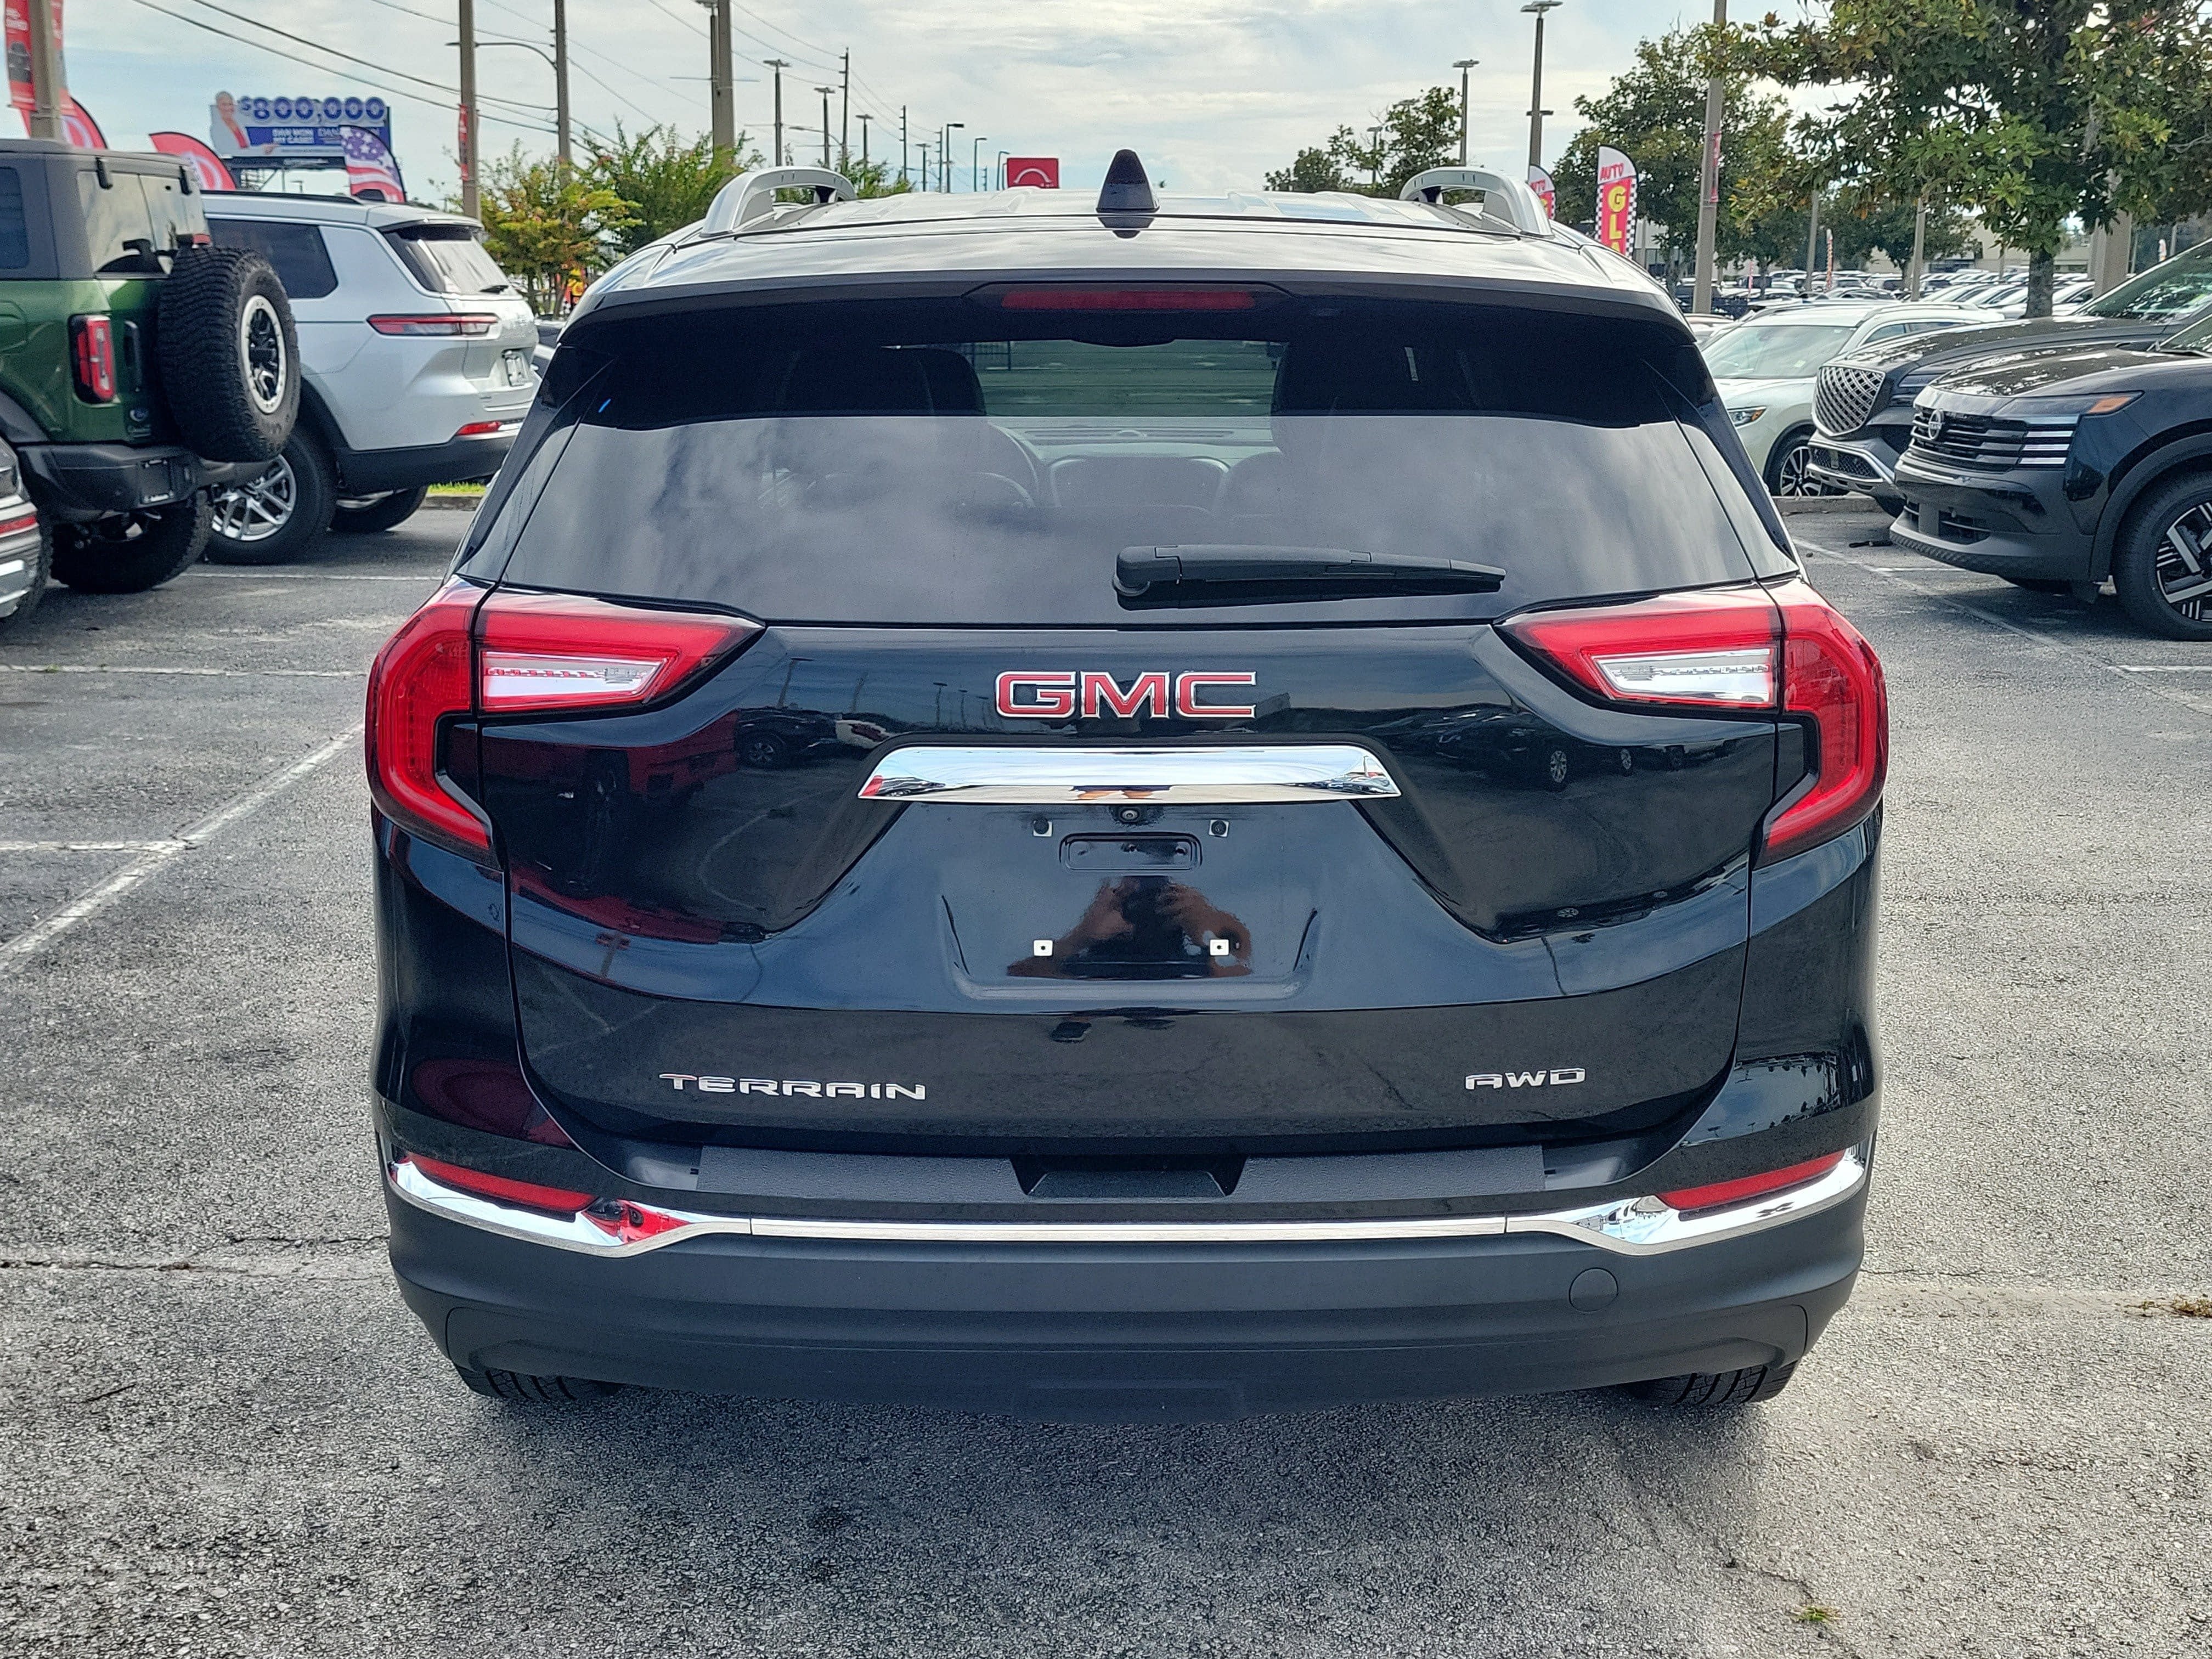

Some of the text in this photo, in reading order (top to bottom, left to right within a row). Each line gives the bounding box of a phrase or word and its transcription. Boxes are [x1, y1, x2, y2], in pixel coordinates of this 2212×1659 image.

[240, 96, 385, 123] $800,000
[996, 671, 1257, 719] GMC
[658, 1073, 927, 1100] TERRAIN
[1465, 1068, 1586, 1090] AWD
